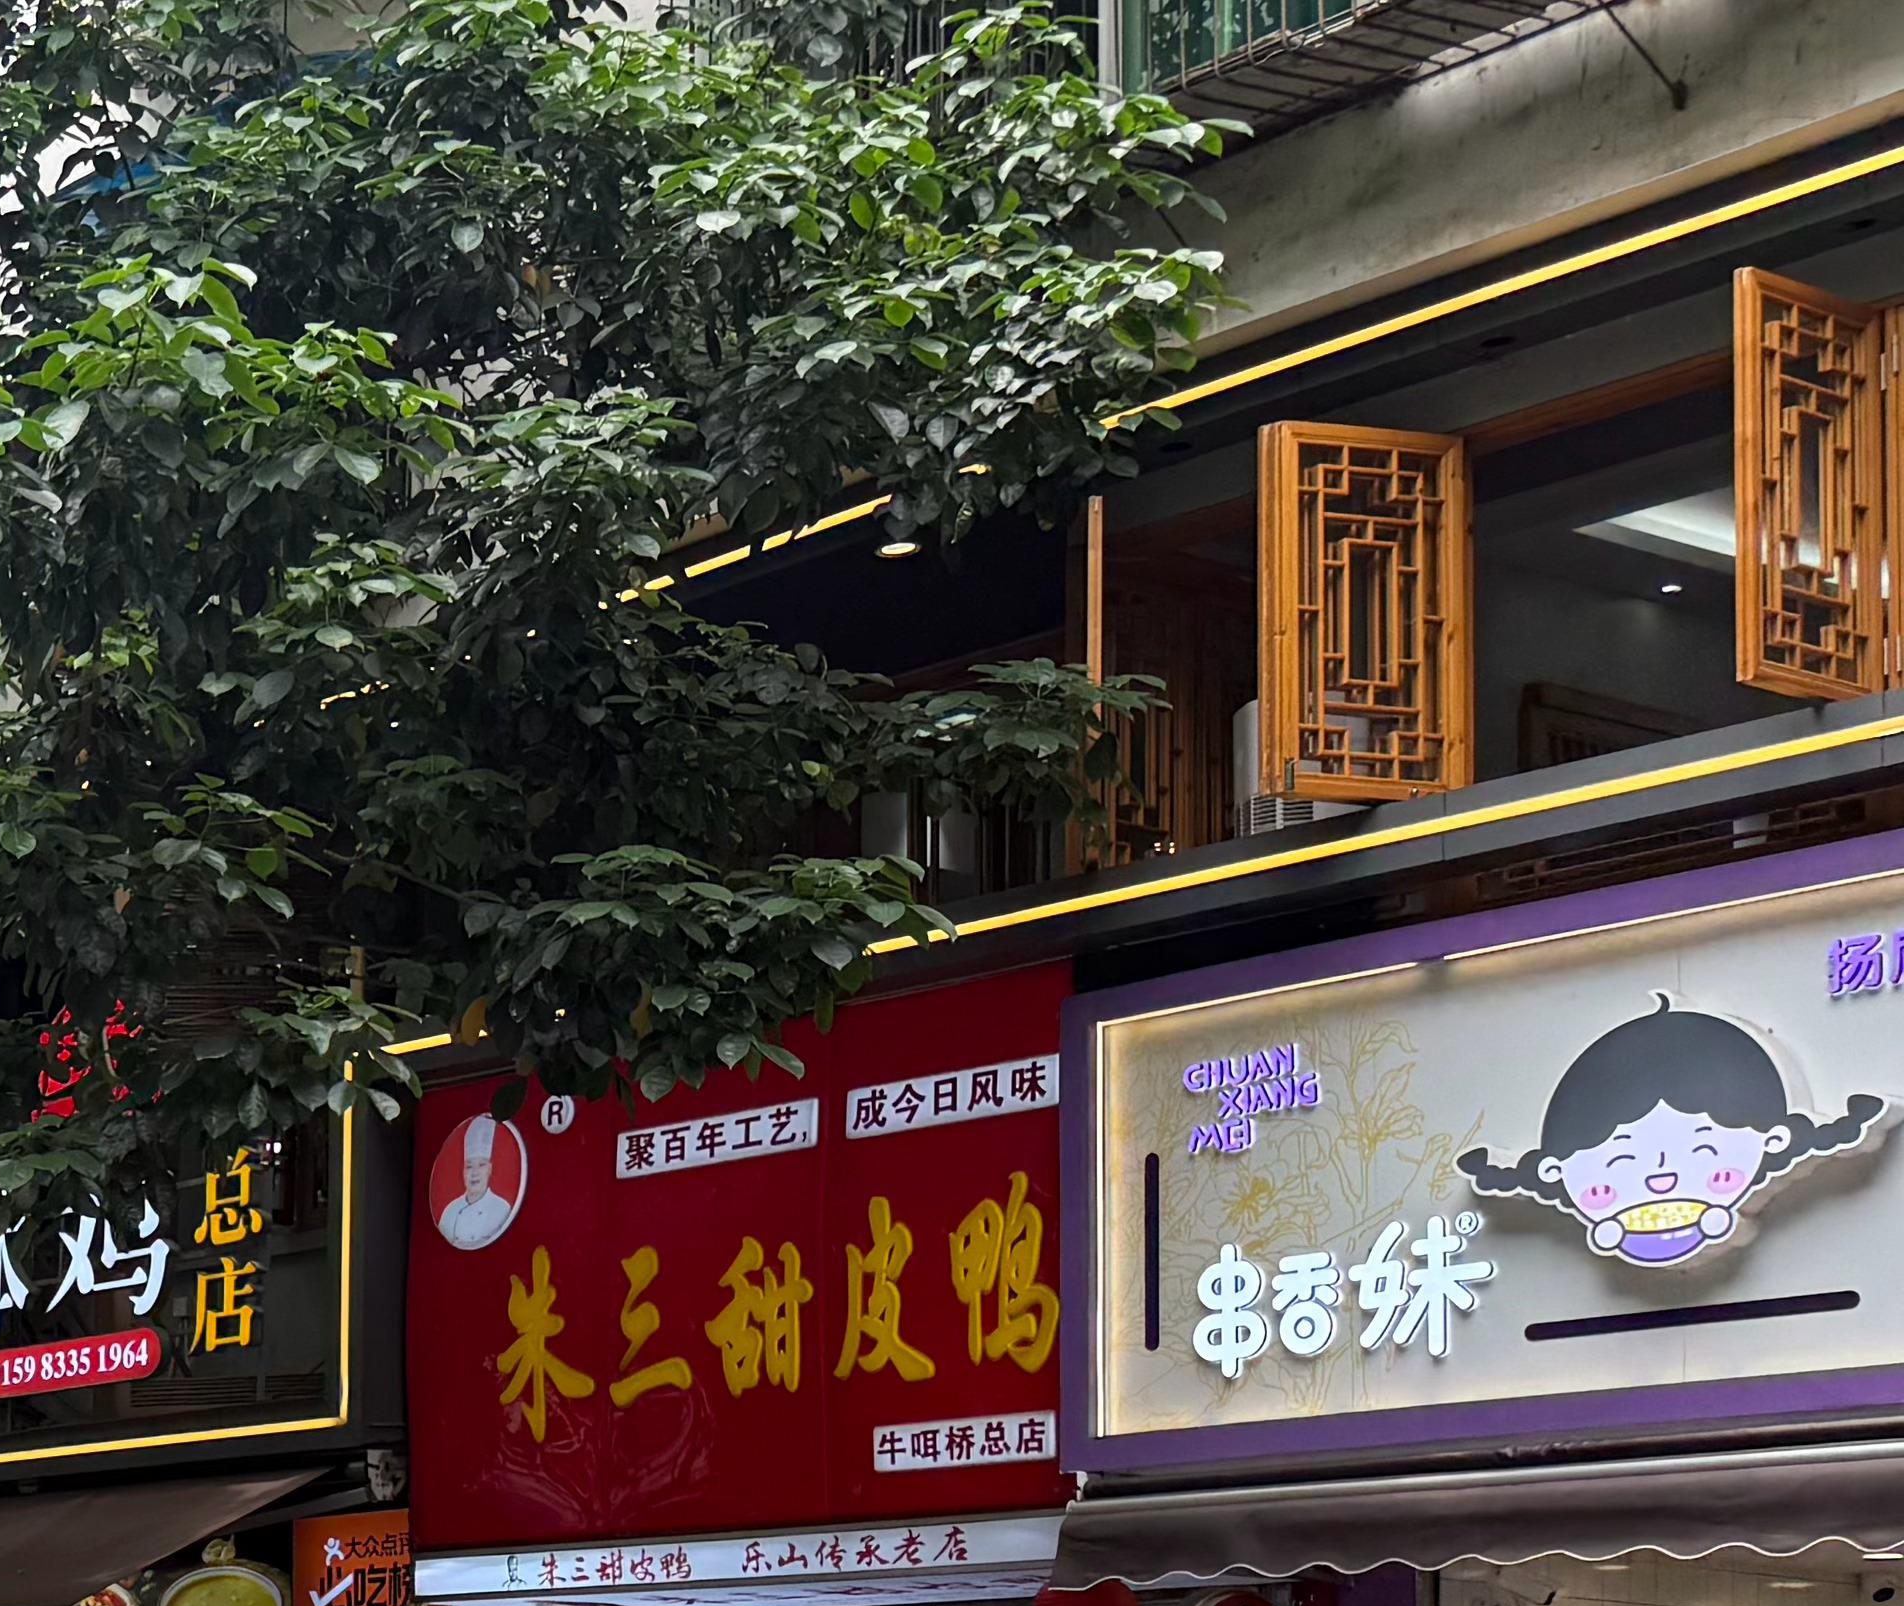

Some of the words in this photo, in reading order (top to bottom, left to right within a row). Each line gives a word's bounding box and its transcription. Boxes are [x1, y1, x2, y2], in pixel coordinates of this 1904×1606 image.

[1828, 930, 1904, 995] 扬
[1183, 1044, 1299, 1093] CHUAN
[852, 1060, 1050, 1132] 成今日风味
[1218, 1072, 1319, 1117] XIANG
[1189, 1119, 1253, 1153] MEI
[191, 1147, 262, 1354] 总店
[496, 1172, 1060, 1443] 朱三甜皮鸭
[1193, 1216, 1493, 1378] 串香妹
[40, 1347, 91, 1380] 8335
[96, 1339, 149, 1373] 1964
[877, 1418, 1048, 1465] 牛咡桥总店
[538, 1543, 692, 1588] 朱三甜皮鸭
[741, 1526, 969, 1576] 乐山传承老店
